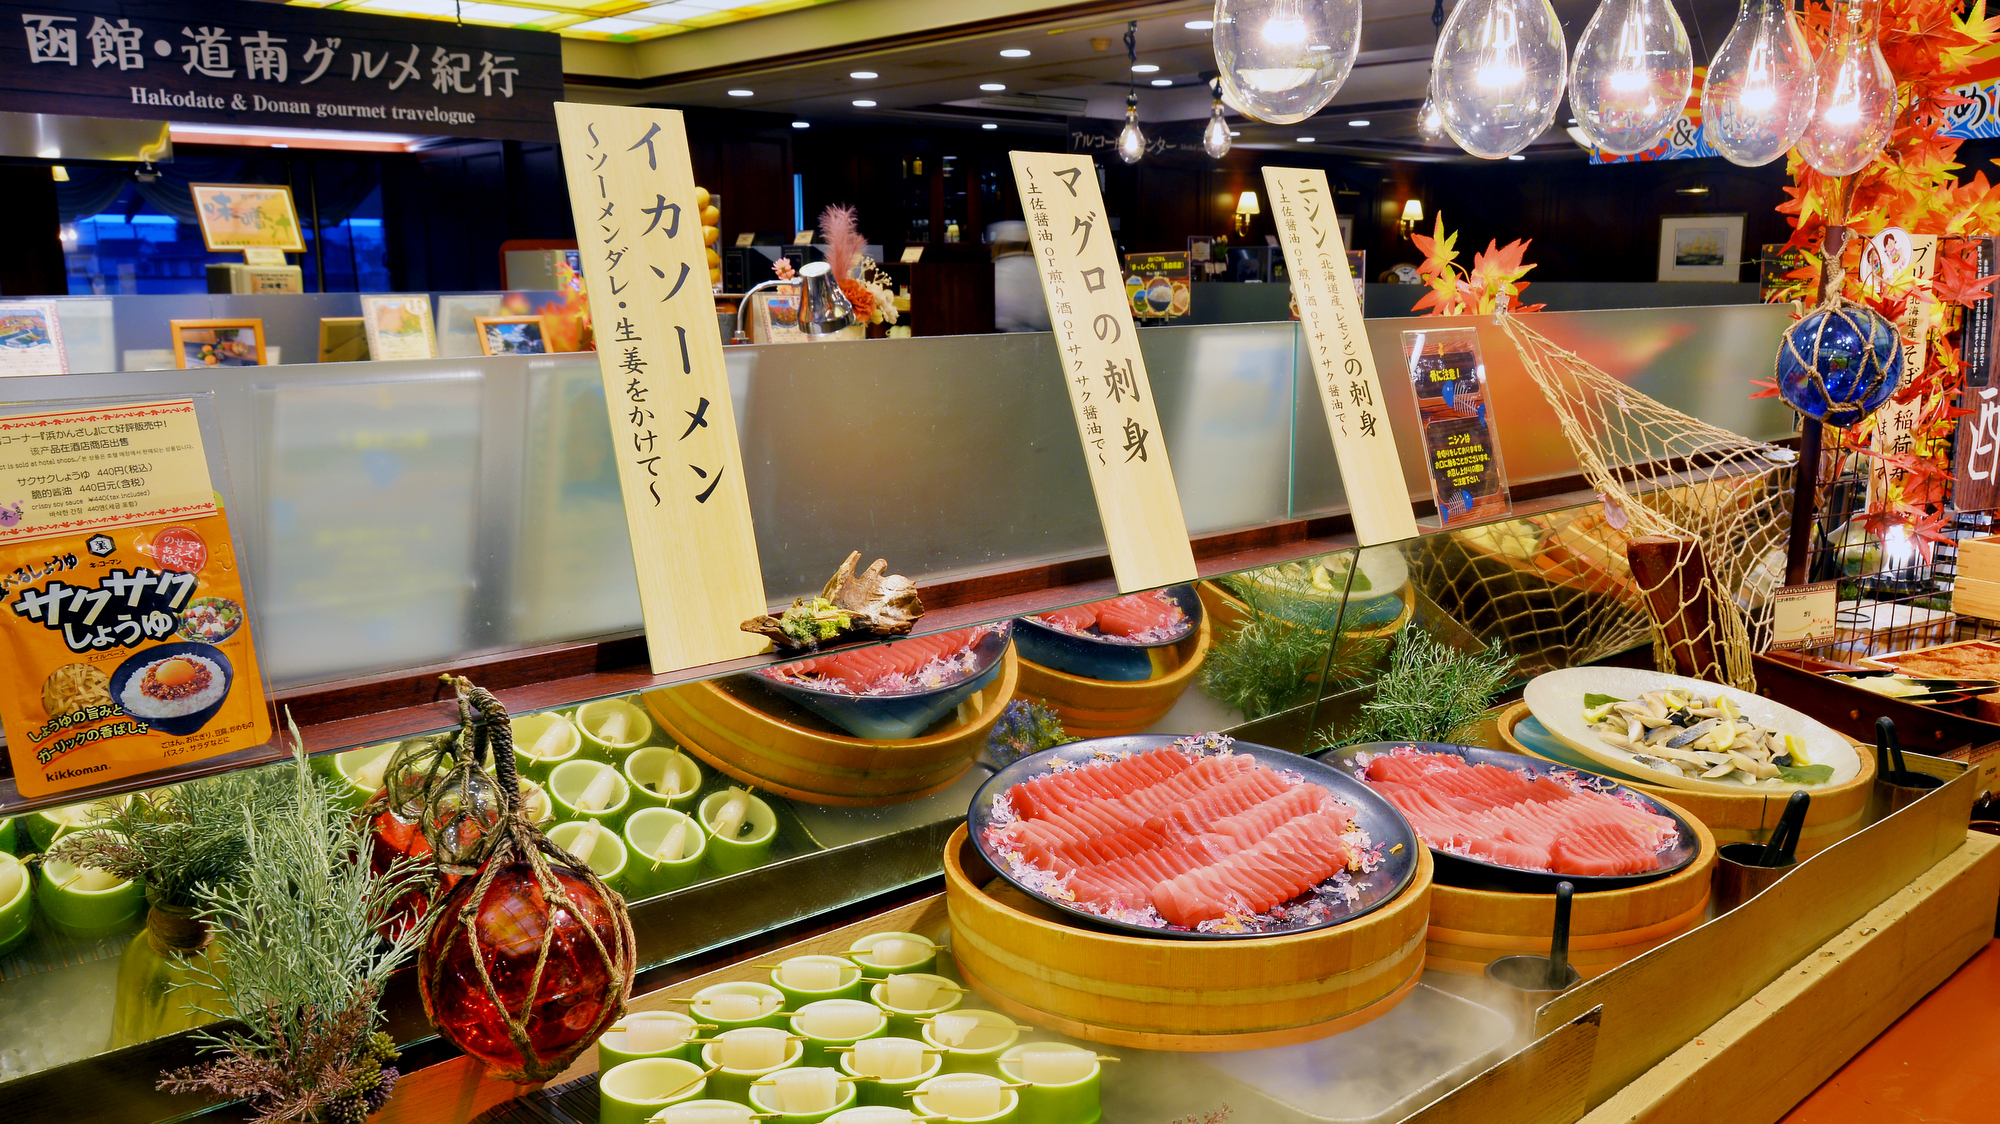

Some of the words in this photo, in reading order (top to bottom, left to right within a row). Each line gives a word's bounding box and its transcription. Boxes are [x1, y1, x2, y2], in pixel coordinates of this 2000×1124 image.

[22, 13, 520, 98] 函館・道南グルメ紀行
[130, 86, 225, 110] Hakodate
[230, 93, 248, 111] &
[253, 95, 311, 115] Donan
[316, 102, 387, 119] gourmet
[391, 106, 476, 126] travelogue
[626, 122, 725, 504] イカソーメン
[1053, 165, 1149, 464] マグロの刺身
[17, 470, 91, 487] サクサクしょうゆ
[97, 463, 153, 476] 440円(税込)
[89, 559, 122, 568] キッコーマン
[15, 570, 196, 626] サクサク
[63, 611, 173, 649] しょうゆ
[87, 651, 126, 662] オイルベース
[28, 704, 124, 743] しょうゆの旨みと
[37, 721, 150, 764] ガーリックの香ばしさ
[46, 763, 108, 782] kikkoman
